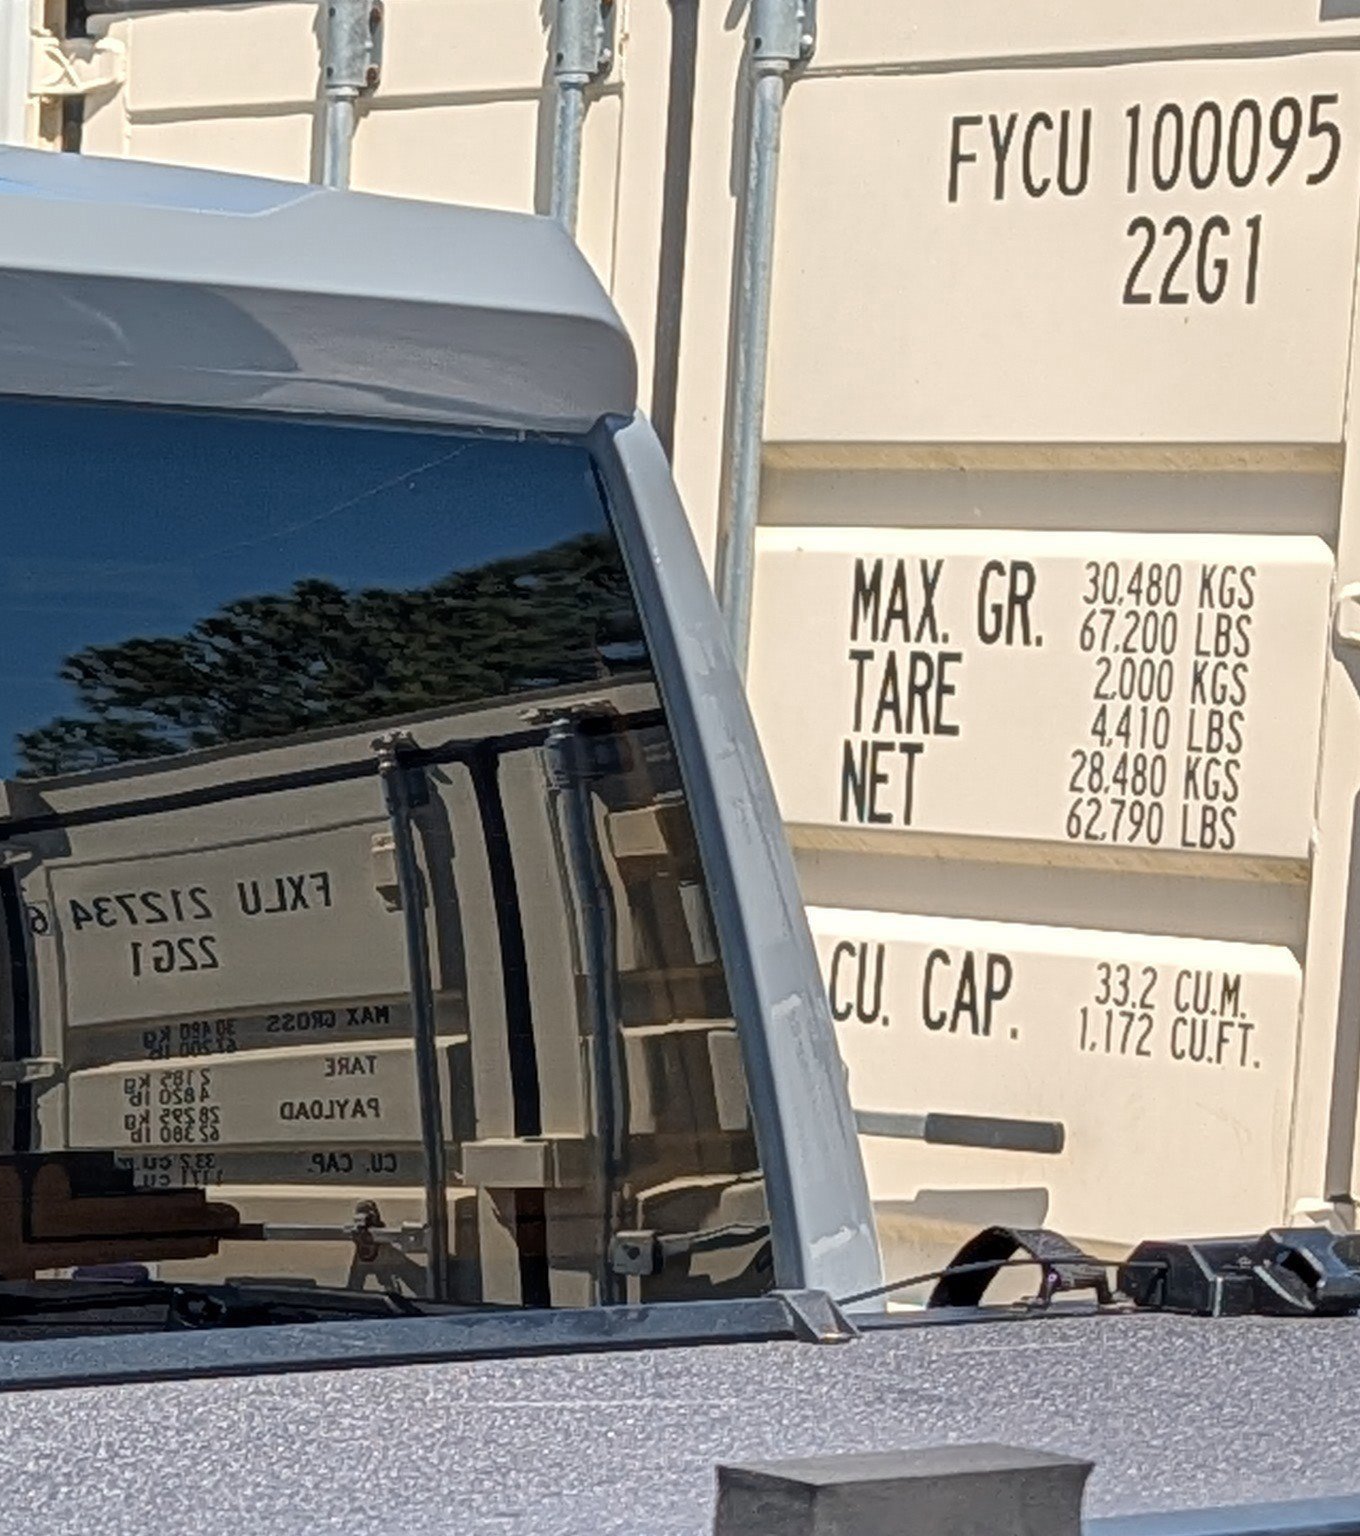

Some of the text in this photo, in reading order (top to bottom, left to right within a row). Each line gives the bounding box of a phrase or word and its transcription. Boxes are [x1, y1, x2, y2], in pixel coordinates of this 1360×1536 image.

[948, 93, 1341, 202] FYCU 100095
[1122, 213, 1263, 305] 22G1
[849, 558, 1043, 646] MAX. GR.
[1198, 565, 1256, 609] KGS
[1079, 608, 1251, 658] 67,200 LBS
[848, 650, 963, 737] TARE
[1093, 656, 1249, 706] 2,000 KGS
[1091, 703, 1244, 754] 4,410 LBS
[839, 740, 924, 825] NET
[1183, 755, 1240, 802] KGS
[1066, 797, 1237, 850] 62,790 LBS
[828, 940, 1019, 1039] CU. CAP.
[1094, 961, 1247, 1019] 33.2 CU.M.
[1079, 1006, 1261, 1069] 1,172 CU.FT.
